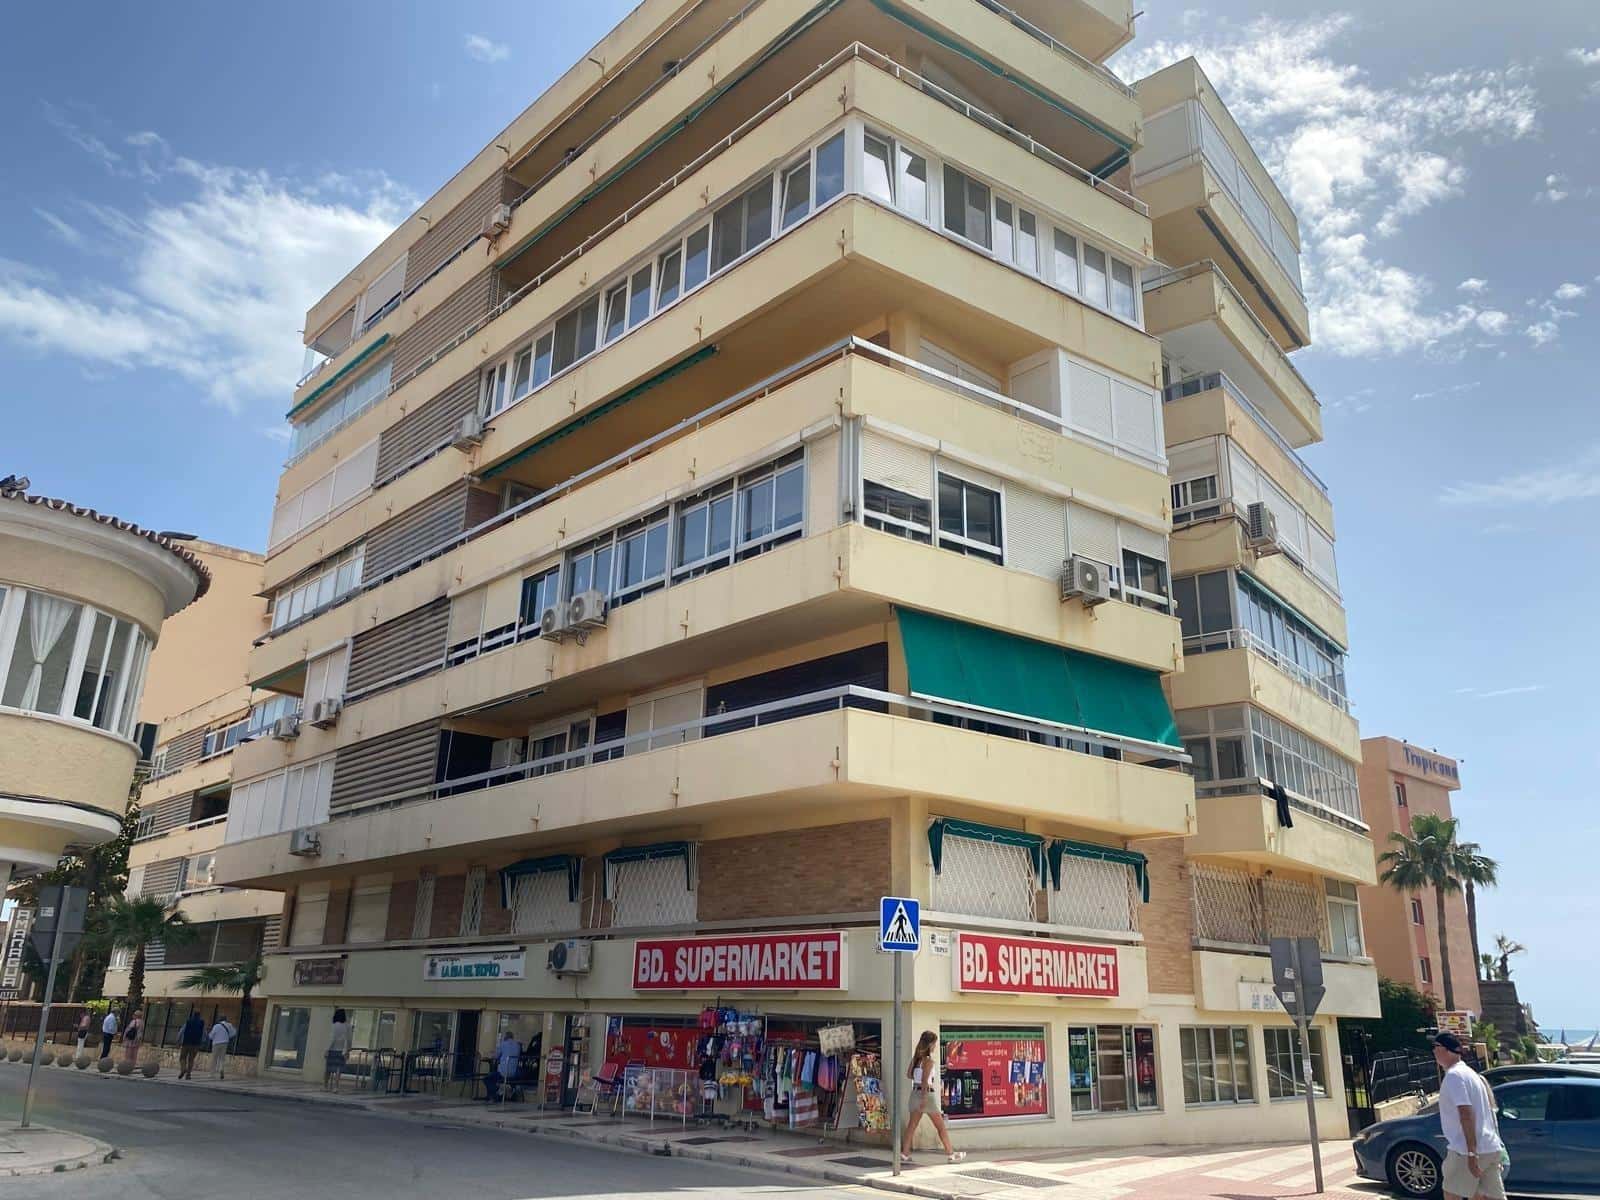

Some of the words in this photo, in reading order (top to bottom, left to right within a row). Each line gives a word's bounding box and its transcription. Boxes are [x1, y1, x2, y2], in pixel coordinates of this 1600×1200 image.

[638, 948, 669, 983] BD.
[674, 940, 838, 983] SUPERMARKET
[962, 941, 994, 984] BD.
[998, 944, 1116, 990] SUPERMARKET
